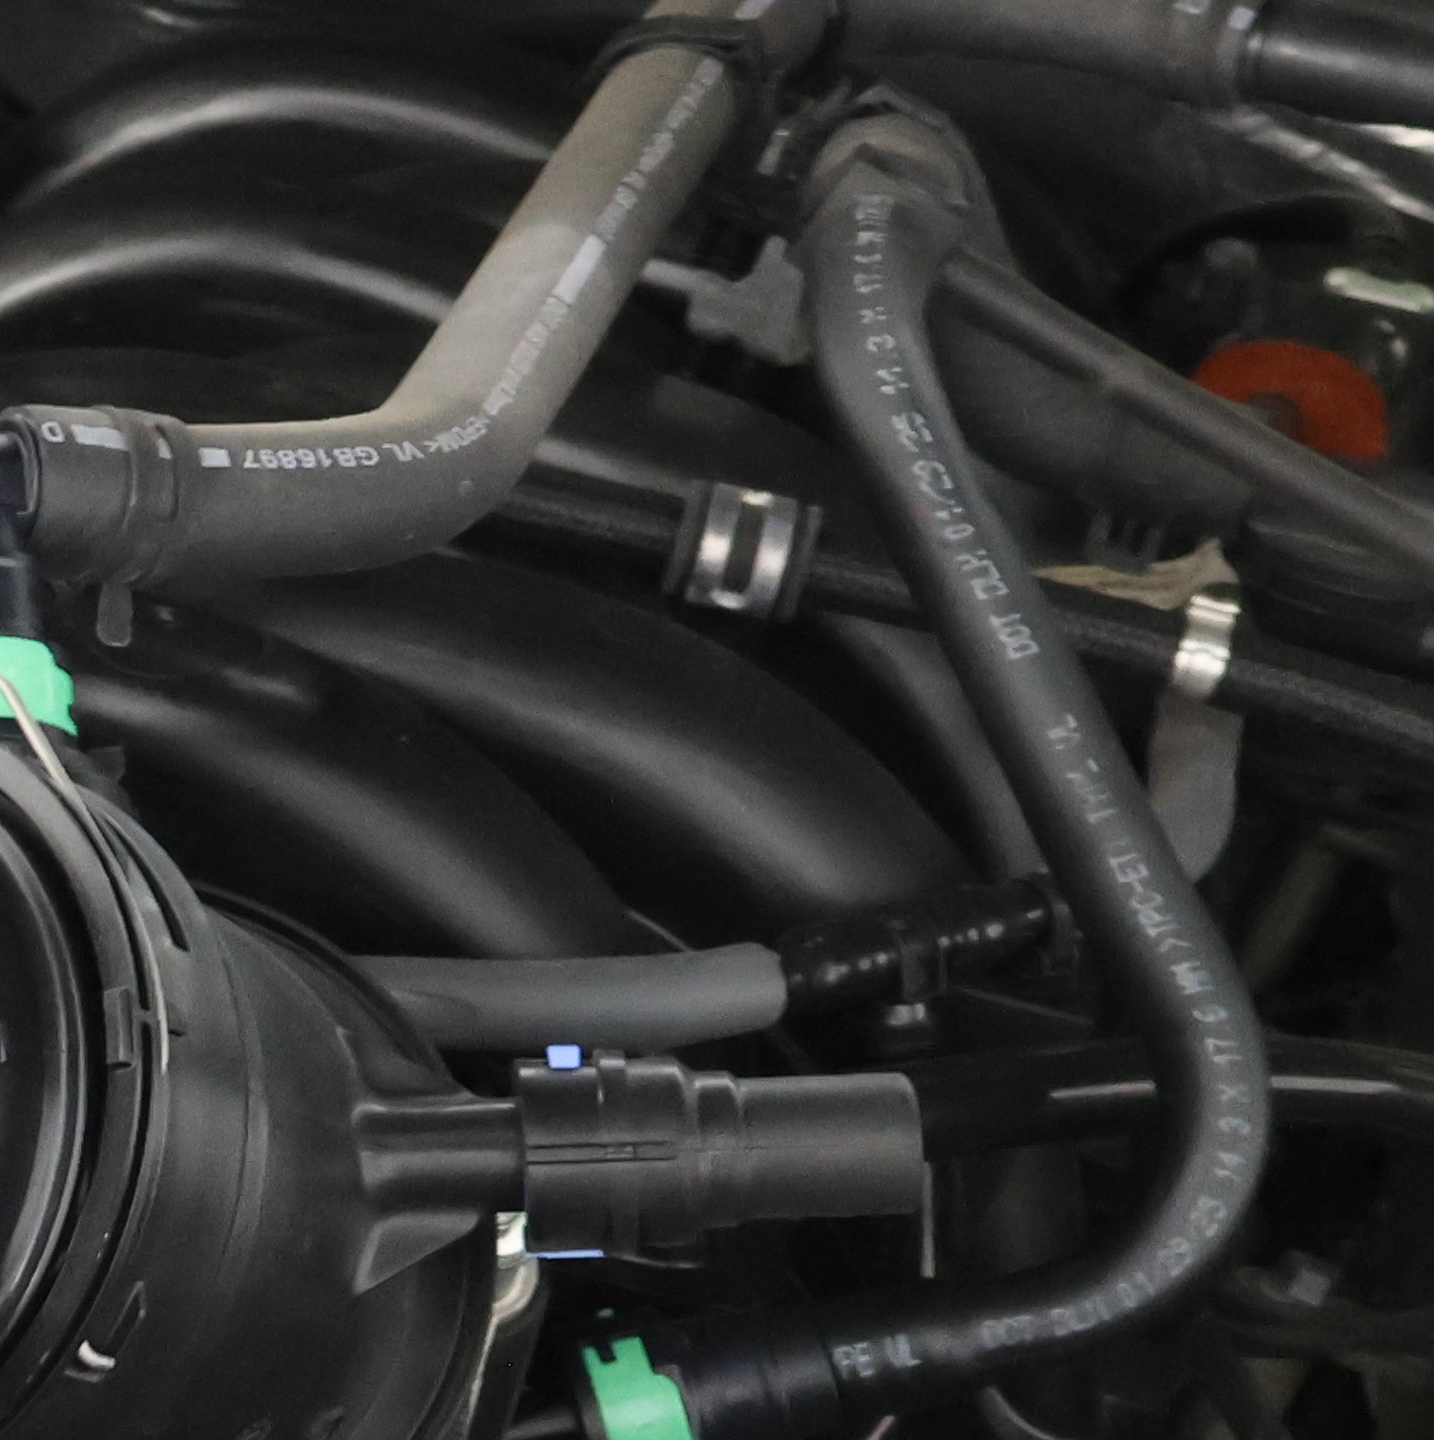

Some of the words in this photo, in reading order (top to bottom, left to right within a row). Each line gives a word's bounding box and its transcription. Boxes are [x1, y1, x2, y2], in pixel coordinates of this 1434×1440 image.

[40, 420, 66, 444] D
[243, 444, 380, 469] GB16897
[383, 440, 424, 463] VL
[986, 611, 1041, 659] DOT
